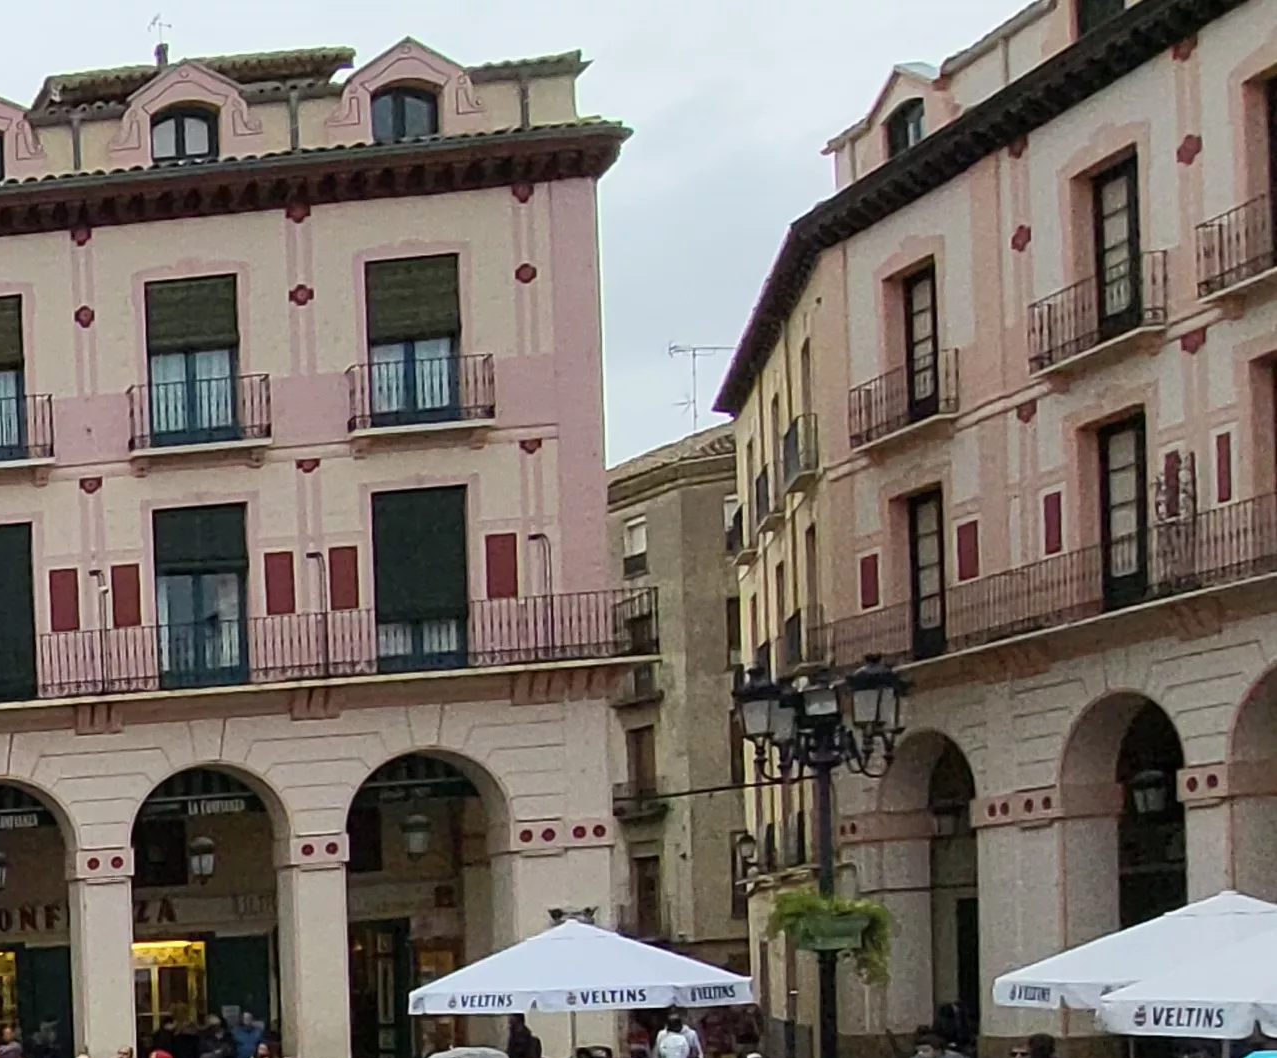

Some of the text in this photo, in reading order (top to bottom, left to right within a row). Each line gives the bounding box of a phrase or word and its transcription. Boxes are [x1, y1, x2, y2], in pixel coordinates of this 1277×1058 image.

[460, 994, 513, 1008] VELTINS
[580, 989, 647, 1005] VELTINS
[1152, 1007, 1225, 1028] VELTINS
